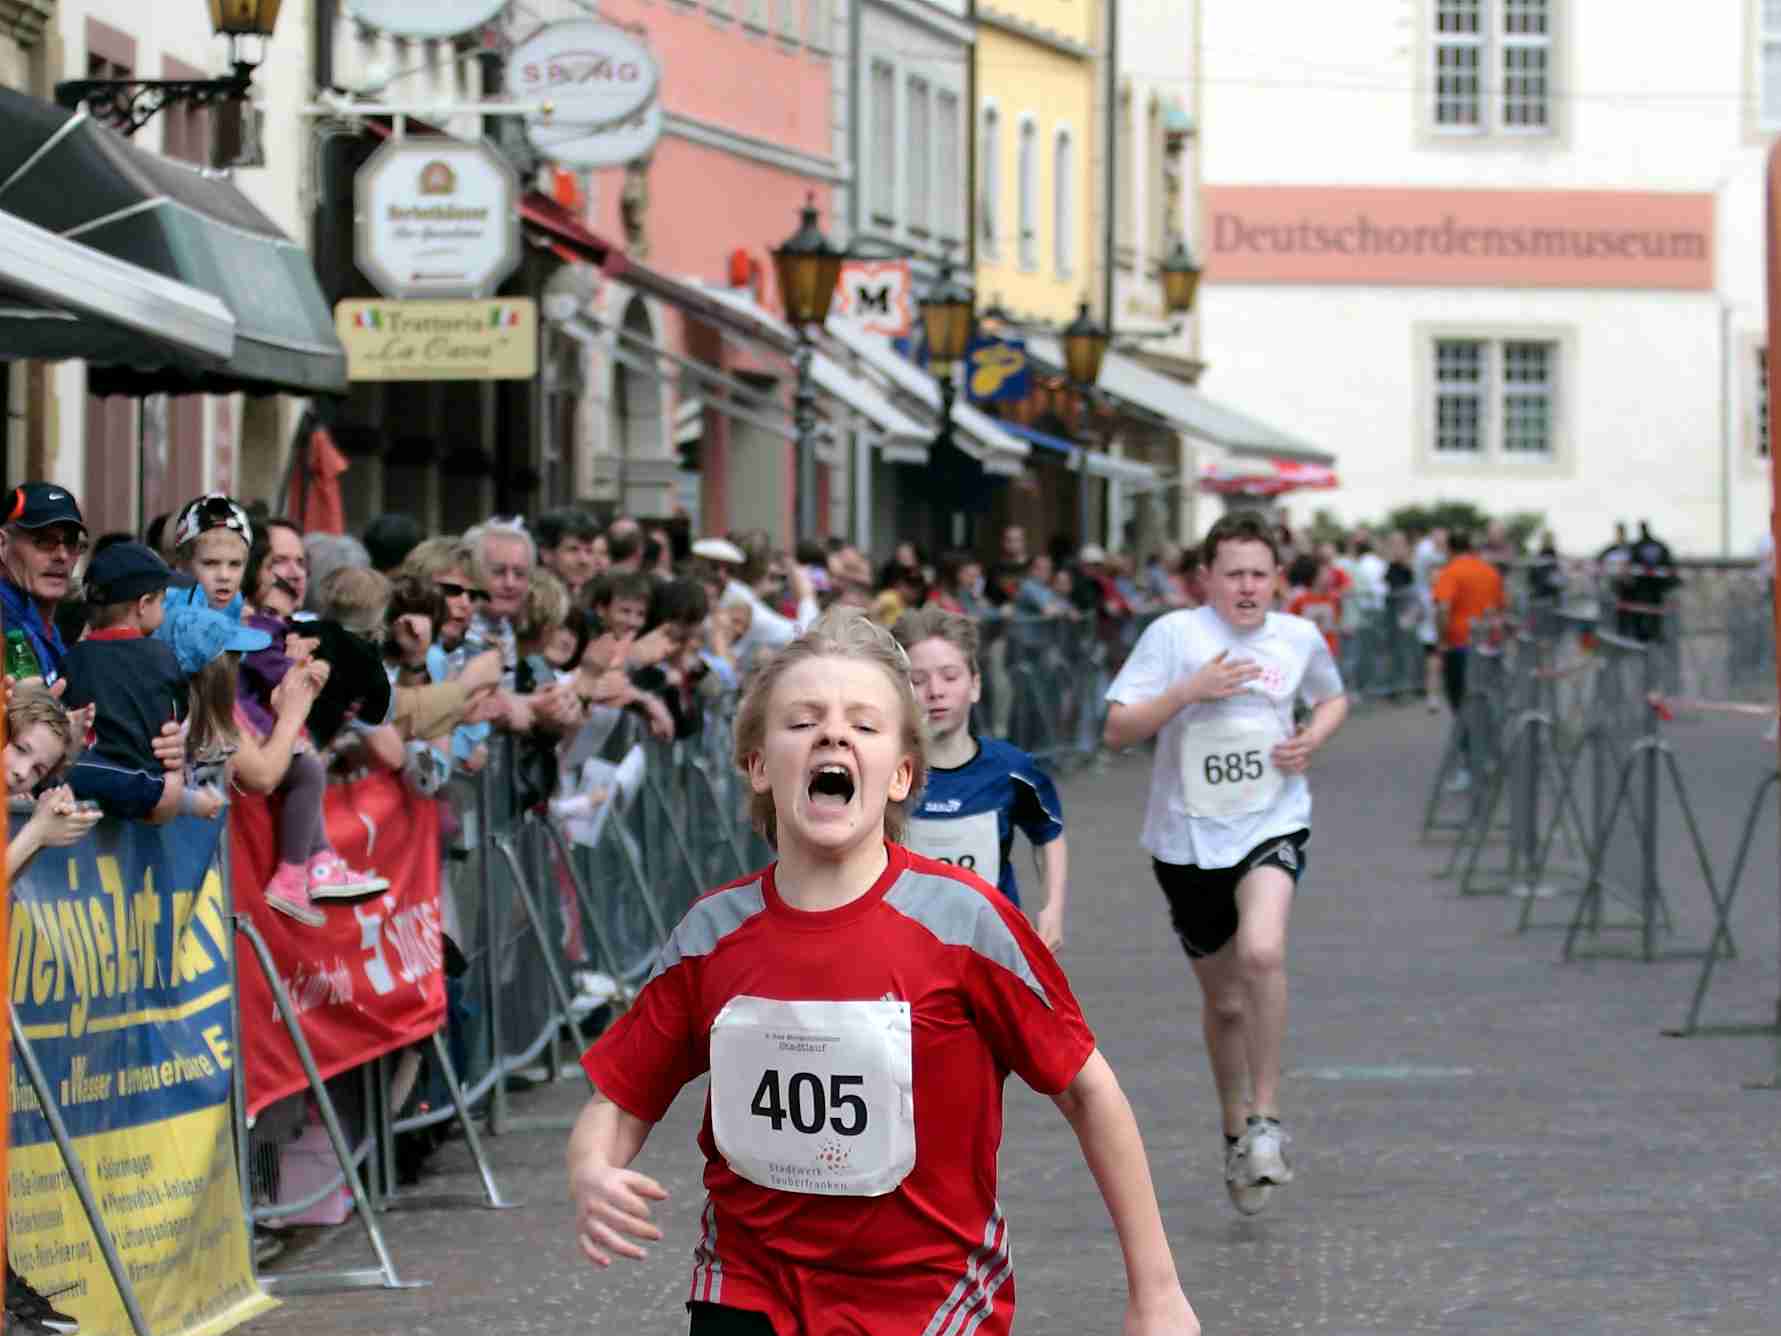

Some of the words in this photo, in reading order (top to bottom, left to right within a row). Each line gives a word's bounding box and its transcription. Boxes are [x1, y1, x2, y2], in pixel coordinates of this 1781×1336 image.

[1213, 212, 1706, 260] Deutschordensmuseum
[856, 284, 888, 315] M
[1204, 750, 1264, 786] 685
[751, 1069, 868, 1137] 405
[769, 1162, 822, 1177] Stadtwerk
